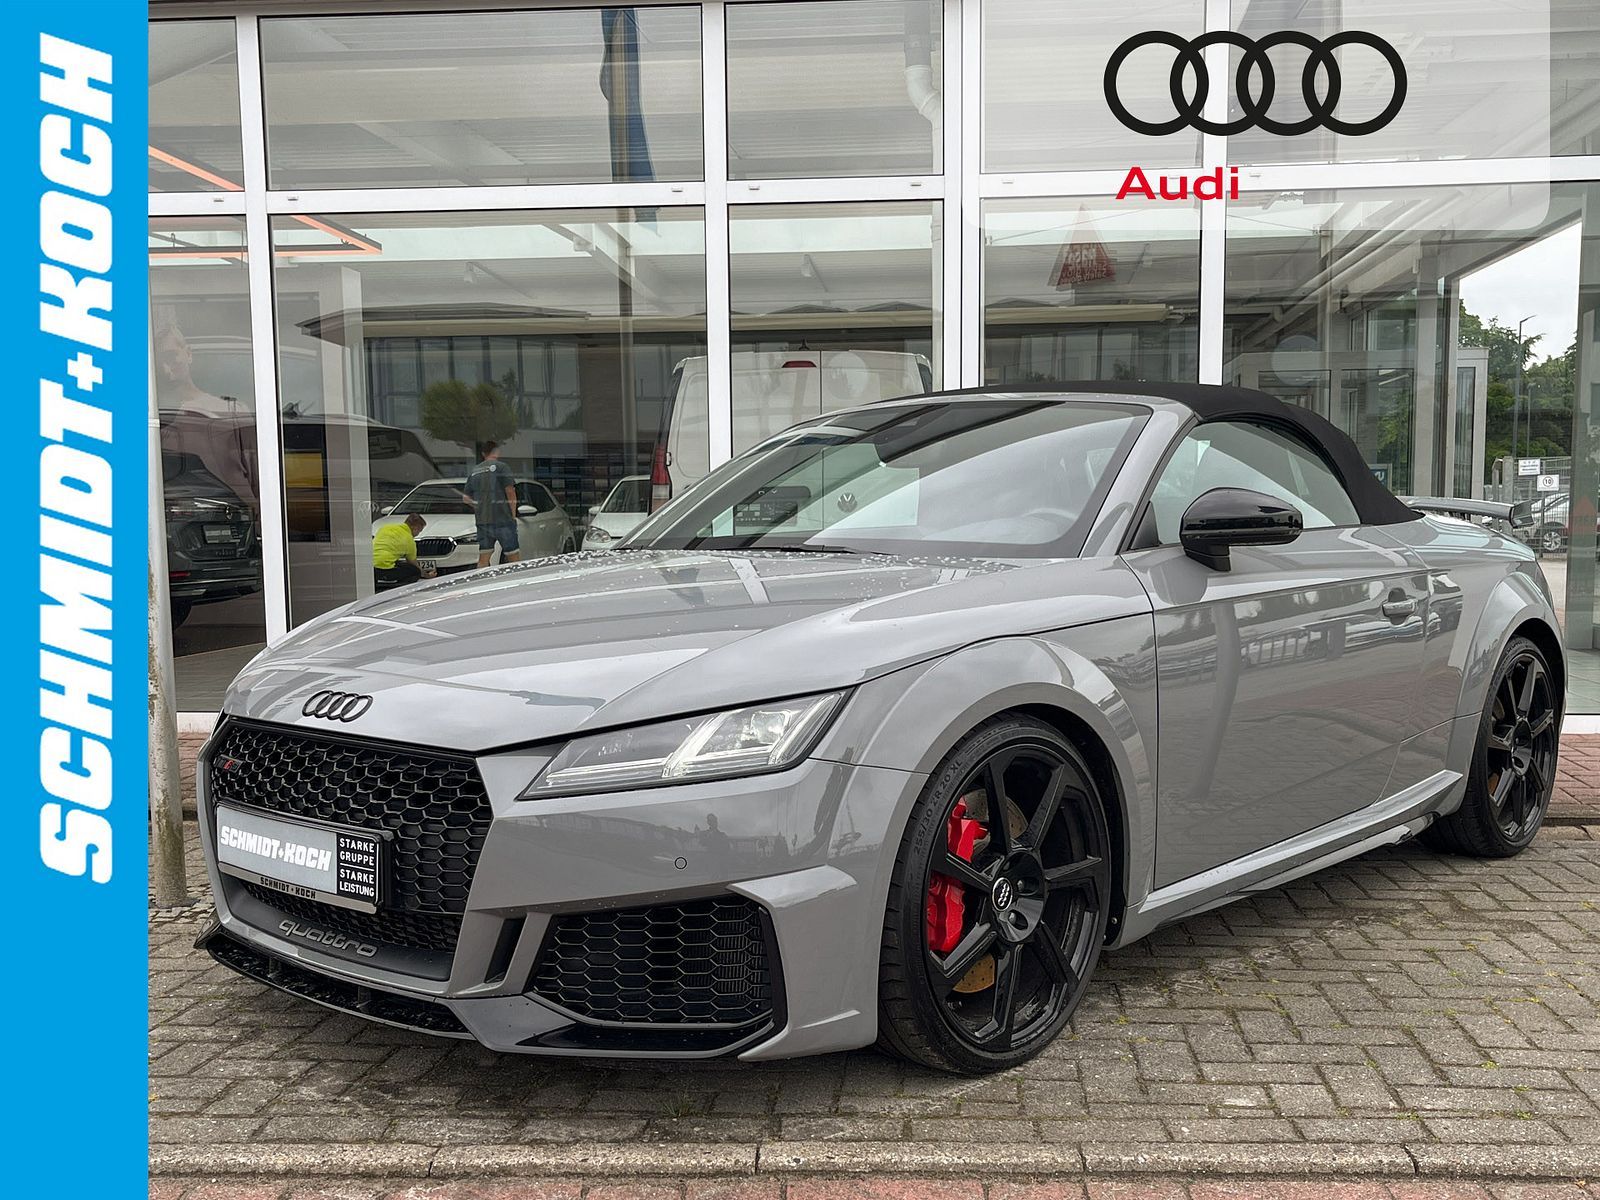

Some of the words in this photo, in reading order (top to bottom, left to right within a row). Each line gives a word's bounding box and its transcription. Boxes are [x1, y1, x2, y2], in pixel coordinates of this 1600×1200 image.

[940, 775, 951, 790] 20
[950, 760, 963, 773] XL
[220, 825, 332, 872] SCHMIDT+KOCH
[339, 838, 375, 853] STARKE
[339, 850, 375, 866] GRUPPE
[339, 869, 375, 884] STARKE
[339, 881, 375, 897] LEISTUNG
[278, 919, 378, 958] quattro
